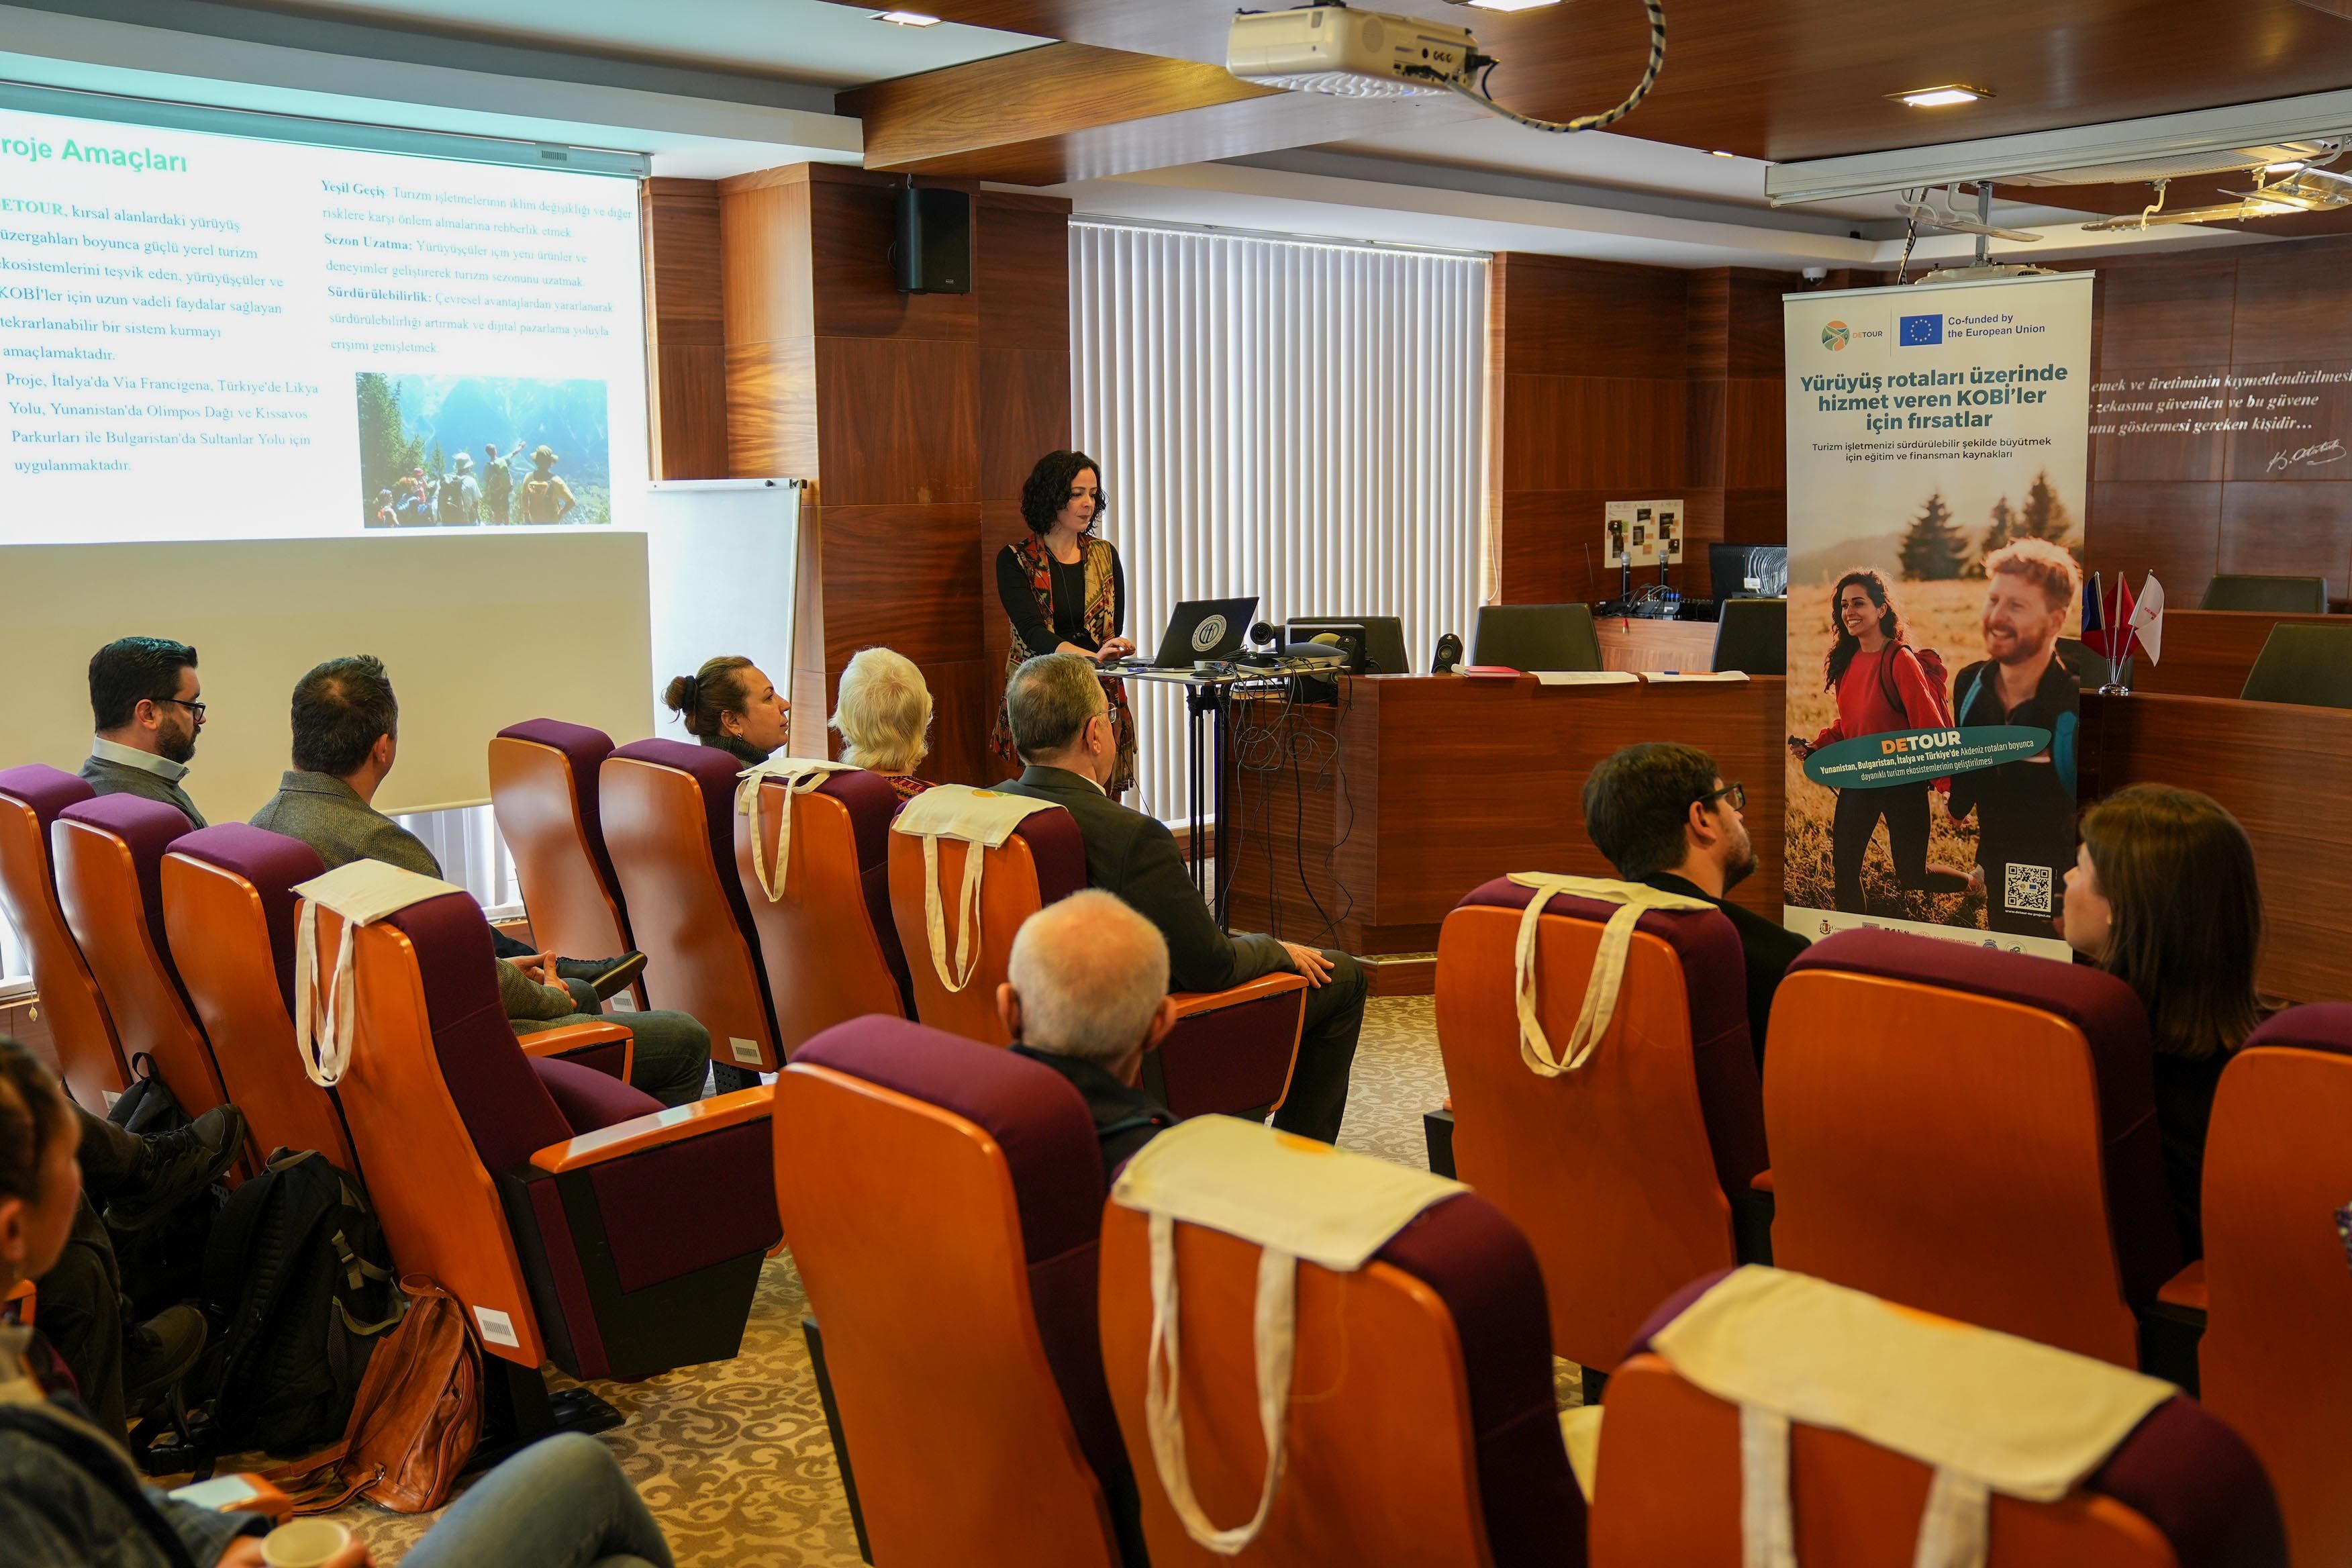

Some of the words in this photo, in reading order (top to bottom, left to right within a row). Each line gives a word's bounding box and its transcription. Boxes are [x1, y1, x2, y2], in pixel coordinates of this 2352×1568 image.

[62, 139, 187, 173] Amaçları
[322, 179, 349, 195] Yeşil
[0, 199, 68, 217] ETOUR,
[72, 205, 109, 220] kırsal
[114, 209, 186, 226] alanlardaki
[190, 217, 240, 233] yürüyüş
[83, 235, 140, 251] boyunca
[144, 242, 179, 255] güçlü
[183, 244, 214, 257] yerel
[218, 246, 258, 259] turizm
[324, 232, 359, 246] Sezon
[363, 236, 413, 251] Uzatma:
[104, 266, 143, 280] teşvik
[148, 268, 182, 282] eden,
[186, 272, 266, 287] yürüyüşçüler
[268, 279, 284, 287] ve
[67, 289, 91, 305] için
[96, 295, 128, 305] uzun
[132, 295, 171, 308] vadeli
[176, 297, 226, 312] faydalar
[230, 301, 282, 316] sağlayan
[328, 286, 432, 303] Sürdürülebilirlik:
[0, 316, 98, 332] tekrarlanabilir
[103, 320, 121, 334] bir
[125, 322, 166, 335] sistem
[170, 324, 222, 340] kurmayı
[1948, 315, 1998, 326] Co-funded
[2002, 313, 2013, 324] by
[1853, 330, 1883, 338] DETOUR
[1948, 329, 1963, 338] the
[1966, 328, 2012, 337] European
[2016, 325, 2045, 334] Union
[3, 346, 116, 360] amaçlamaktadır.
[6, 373, 47, 389] Proje,
[52, 373, 109, 390] İtalya'da
[113, 377, 136, 389] Via
[141, 377, 214, 393] Francigena,
[217, 379, 281, 395] Türkiye'de
[285, 382, 319, 397] Likya
[1800, 372, 1882, 393] Yürüyüş
[1888, 369, 1964, 388] rotaları
[1970, 363, 2068, 384] üzerinde
[2130, 381, 2145, 390] ve
[2148, 373, 2220, 390] üretiminin
[9, 402, 46, 416] Yolu,
[50, 403, 142, 416] Yunanistan'da
[147, 405, 201, 420] Olimpos
[205, 405, 234, 421] Dağı
[238, 409, 252, 418] ve
[1818, 393, 1889, 411] hizmet
[1893, 393, 1951, 409] veren
[2096, 400, 2153, 414] zekasına
[2155, 396, 2224, 413] güvenilen
[2228, 398, 2243, 408] ve
[2247, 394, 2265, 407] bu
[2266, 394, 2320, 410] güvene
[1867, 413, 1902, 435] için
[1908, 411, 1993, 429] fırsatlar
[2118, 418, 2192, 436] göstermesi
[2192, 418, 2249, 435] gereken
[11, 430, 81, 443] Parkurları
[85, 431, 101, 443] ile
[106, 432, 197, 447] Bulgaristan'da
[200, 433, 254, 445] Sultanlar
[258, 434, 285, 445] Yolu
[289, 435, 311, 447] için
[1812, 442, 1843, 451] Turizm
[1845, 440, 1894, 452] işletmenizi
[1897, 439, 1960, 450] sürdürülebilir
[1963, 438, 1998, 449] şekilde
[2000, 437, 2051, 448] büyütmek
[1846, 453, 1862, 463] için
[1865, 452, 1894, 462] eğitim
[1910, 451, 1960, 460] finansman
[1963, 450, 2012, 460] kaynakları
[15, 459, 132, 474] uygulanmaktadır.
[1881, 730, 1962, 754] DETOUR
[1820, 763, 1857, 775] Yunanistan,
[1857, 758, 1897, 770] Bulgaristan,
[1896, 754, 1916, 765] İtalya
[1925, 748, 1960, 761] Türkiye'de
[1961, 745, 1983, 756] Akdeniz
[1985, 743, 2008, 753] rotaları
[2008, 740, 2035, 751] boyunca
[1861, 770, 1886, 781] dayanıklı
[1887, 768, 1906, 778] turizm
[1906, 761, 1955, 775] ekosistemlerinin
[1954, 756, 1994, 771] geliştirilmesi
